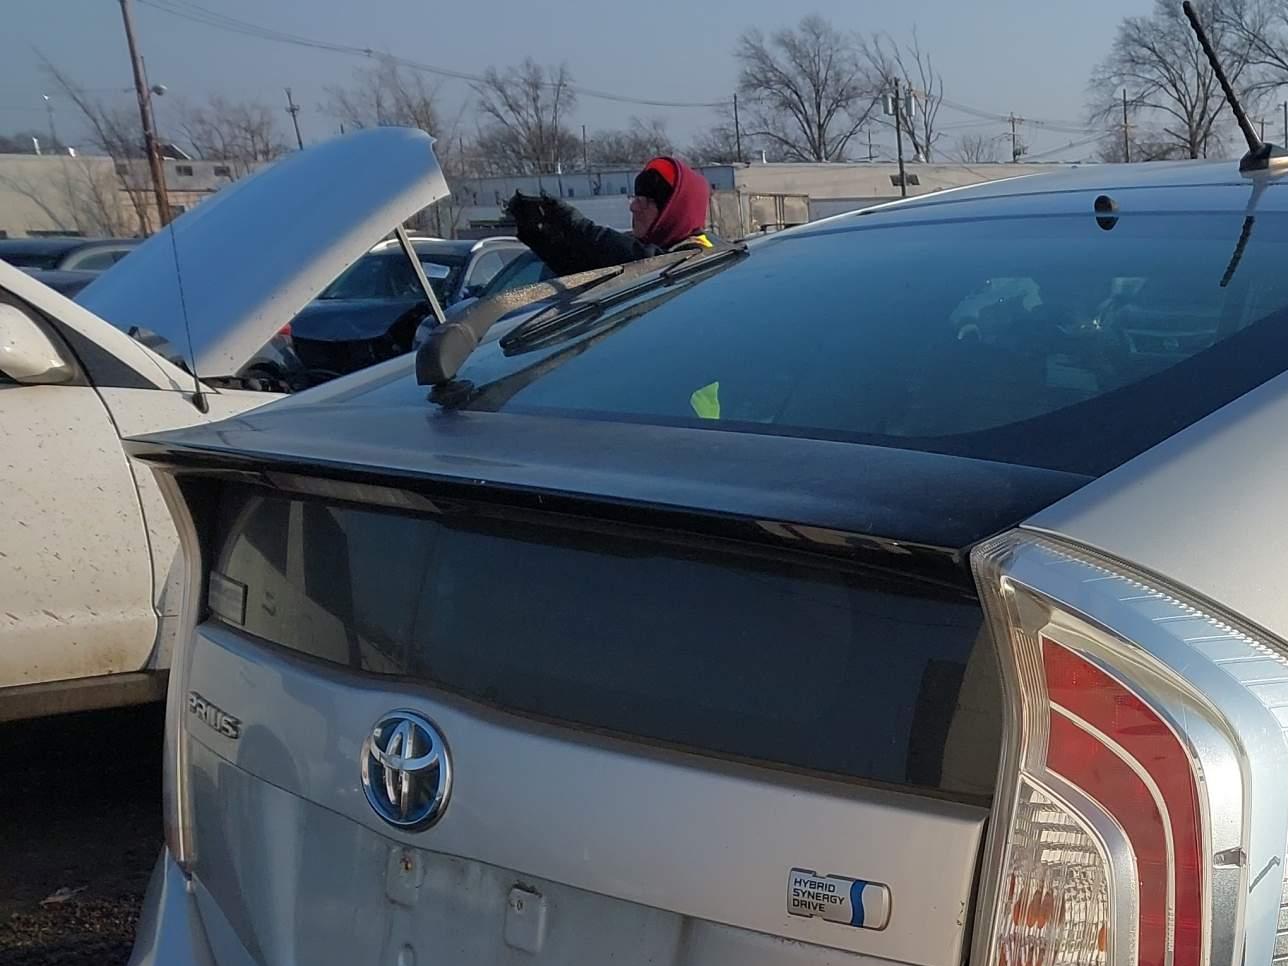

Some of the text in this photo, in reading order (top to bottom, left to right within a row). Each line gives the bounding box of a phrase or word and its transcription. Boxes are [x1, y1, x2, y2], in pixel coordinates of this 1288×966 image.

[793, 878, 836, 893] HYBRID
[792, 888, 845, 905] SYNERGY
[792, 898, 825, 912] DRIVE
